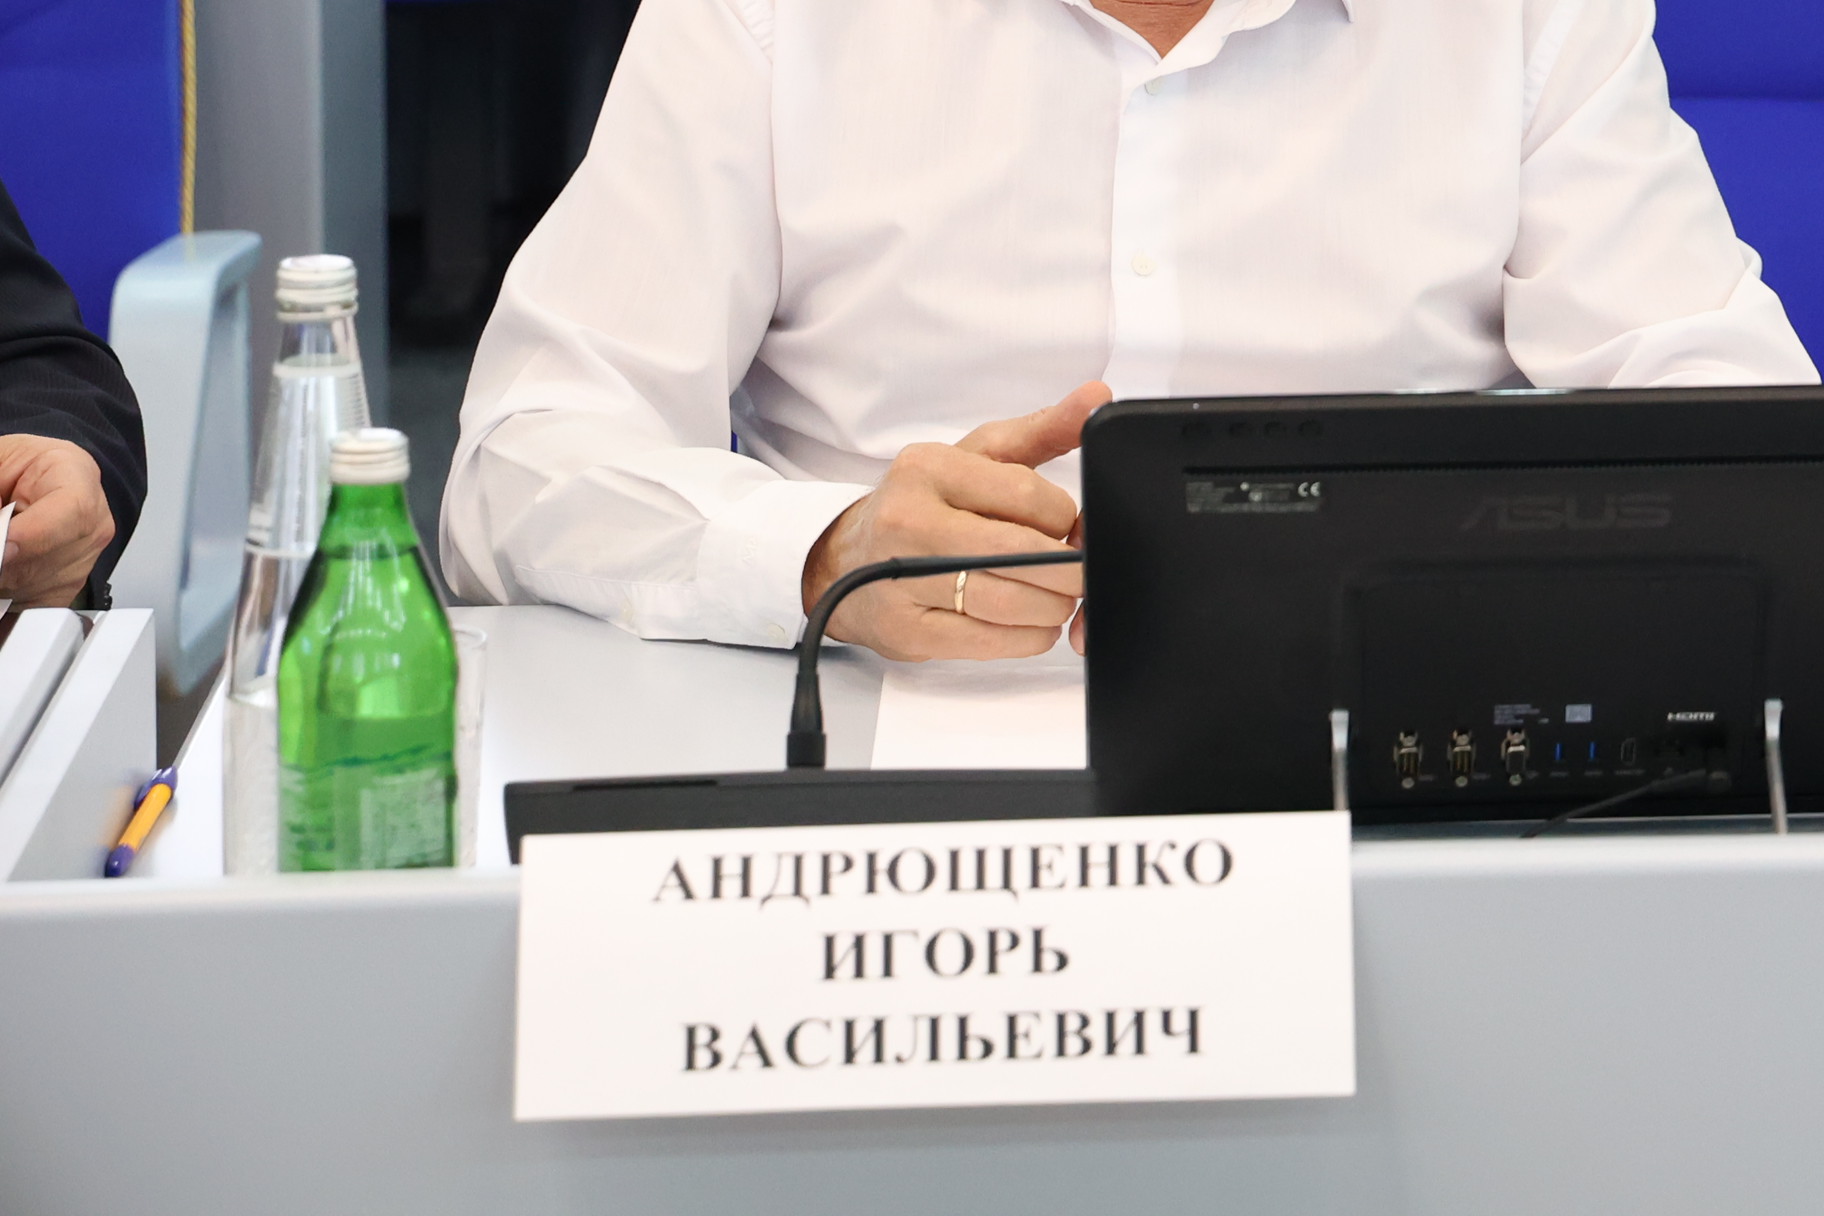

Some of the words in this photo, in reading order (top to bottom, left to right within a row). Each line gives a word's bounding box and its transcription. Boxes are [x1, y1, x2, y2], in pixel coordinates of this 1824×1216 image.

[1456, 493, 1674, 531] ASUS
[653, 840, 1234, 908] АНДРЮЩЕНКО
[821, 926, 1070, 982] ИГОРЬ
[681, 1006, 1202, 1074] ВАСИЛЬЕВИЧ
